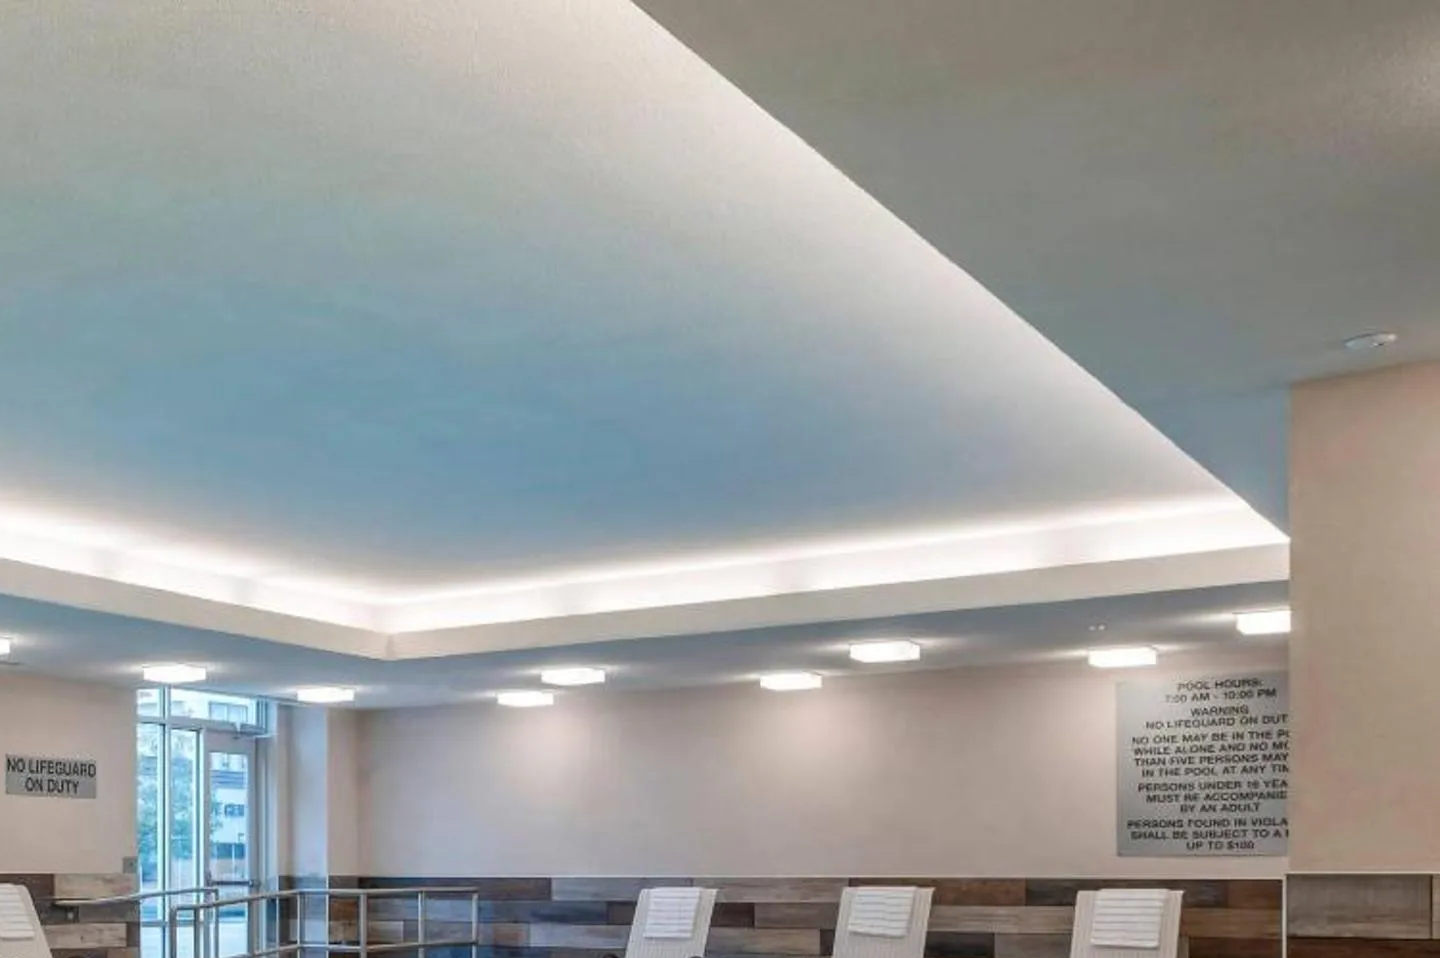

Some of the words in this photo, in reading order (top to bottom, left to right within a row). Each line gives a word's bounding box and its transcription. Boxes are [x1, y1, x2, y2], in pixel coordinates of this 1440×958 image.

[1191, 691, 1210, 702] AM
[1224, 690, 1254, 700] 10:00
[1257, 688, 1277, 698] PM
[1190, 704, 1250, 716] WARNING
[1146, 720, 1164, 730] NO
[1166, 717, 1236, 729] LIFEGUARD
[1240, 715, 1258, 725] ON
[1262, 714, 1288, 725] DUT
[1132, 736, 1149, 745] NO
[1153, 734, 1178, 744] ONE
[1182, 732, 1208, 742] MAY
[1212, 732, 1229, 741] BE
[1232, 731, 1245, 741] IN
[1248, 729, 1273, 740] THE
[1134, 746, 1171, 756] WHILE
[1174, 744, 1216, 755] ALONE
[1220, 743, 1246, 753] AND
[1249, 741, 1269, 751] NO
[1134, 757, 1166, 767] THAN
[1168, 756, 1196, 766] FIVE
[1200, 754, 1258, 765] PERSONS
[1262, 752, 1289, 762] MAY
[7, 757, 26, 773] NO
[28, 759, 97, 778] LIFEGUARD
[1142, 769, 1154, 778] IN
[1160, 767, 1180, 777] THE
[1184, 766, 1218, 776] POOL
[1222, 765, 1237, 775] AT
[1240, 764, 1266, 774] ANY
[25, 777, 43, 792] ON
[47, 778, 80, 794] DUTY
[1138, 781, 1196, 792] PERSONS
[1199, 780, 1242, 791] UNDER
[1263, 778, 1288, 788] YEA
[1146, 793, 1180, 803] MUST
[1184, 793, 1200, 802] BE
[1203, 790, 1288, 801] ACCOMPANIE
[1180, 804, 1196, 813] BY
[1200, 803, 1217, 812] AN
[1220, 802, 1261, 812] ADULT
[1126, 818, 1184, 829] PERSONS
[1187, 817, 1231, 828] FOUND
[1234, 817, 1248, 827] IN
[1251, 816, 1289, 827] VIOLA
[1130, 830, 1171, 840] SHALL
[1172, 829, 1189, 840] BE
[1192, 828, 1249, 839] SUBJECT
[1253, 828, 1270, 839] TO
[1272, 828, 1282, 838] A
[1186, 841, 1203, 850] UP
[1207, 840, 1224, 850] TO
[1226, 840, 1255, 850] $100
